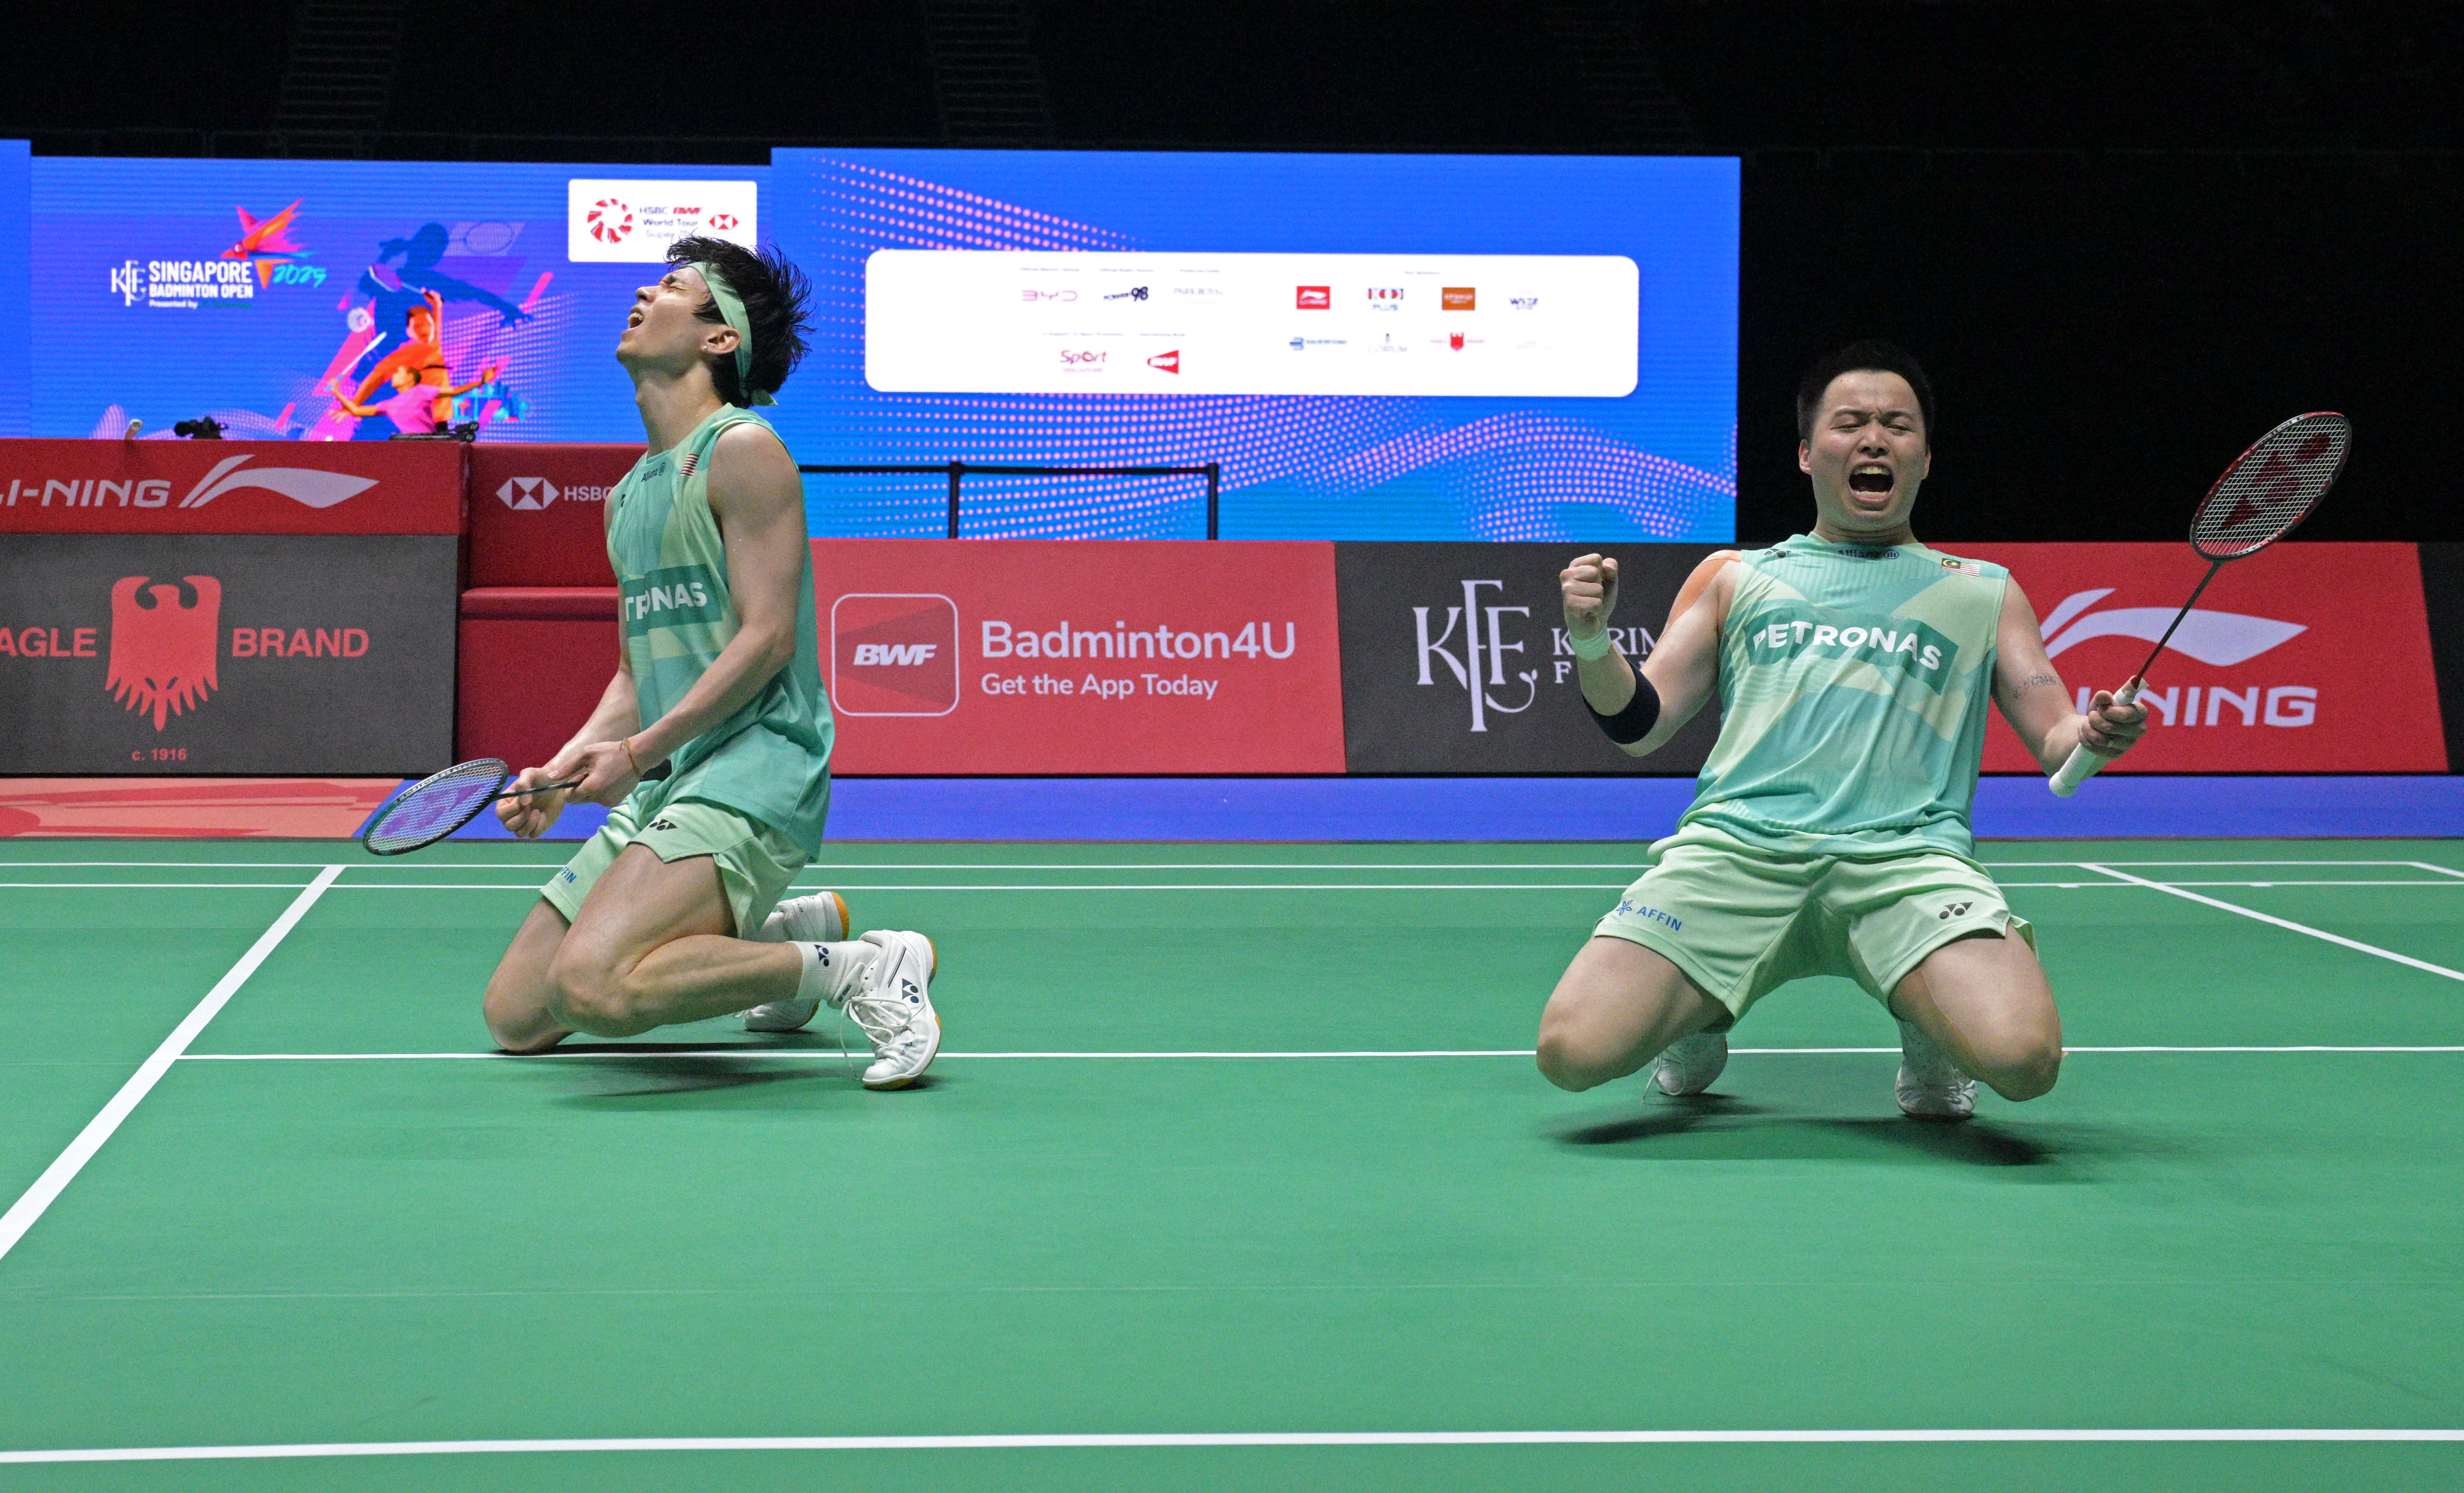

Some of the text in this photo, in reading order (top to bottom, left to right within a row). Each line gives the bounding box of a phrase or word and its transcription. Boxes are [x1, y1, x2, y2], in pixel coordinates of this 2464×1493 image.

[643, 218, 698, 227] World Tour
[148, 261, 253, 283] SINGAPORE
[149, 283, 253, 299] BADMINTON OPEN
[149, 299, 187, 308] Presented
[187, 301, 198, 310] by
[0, 479, 171, 507] I-NING
[232, 628, 368, 657] BRAND
[982, 620, 1296, 659] Badminton4U
[1753, 620, 1942, 671] PETRONAS
[853, 644, 937, 666] BWF
[981, 673, 1219, 700] Get the App Today
[132, 749, 188, 761] c. 1916
[1636, 906, 1682, 932] AFFIN
